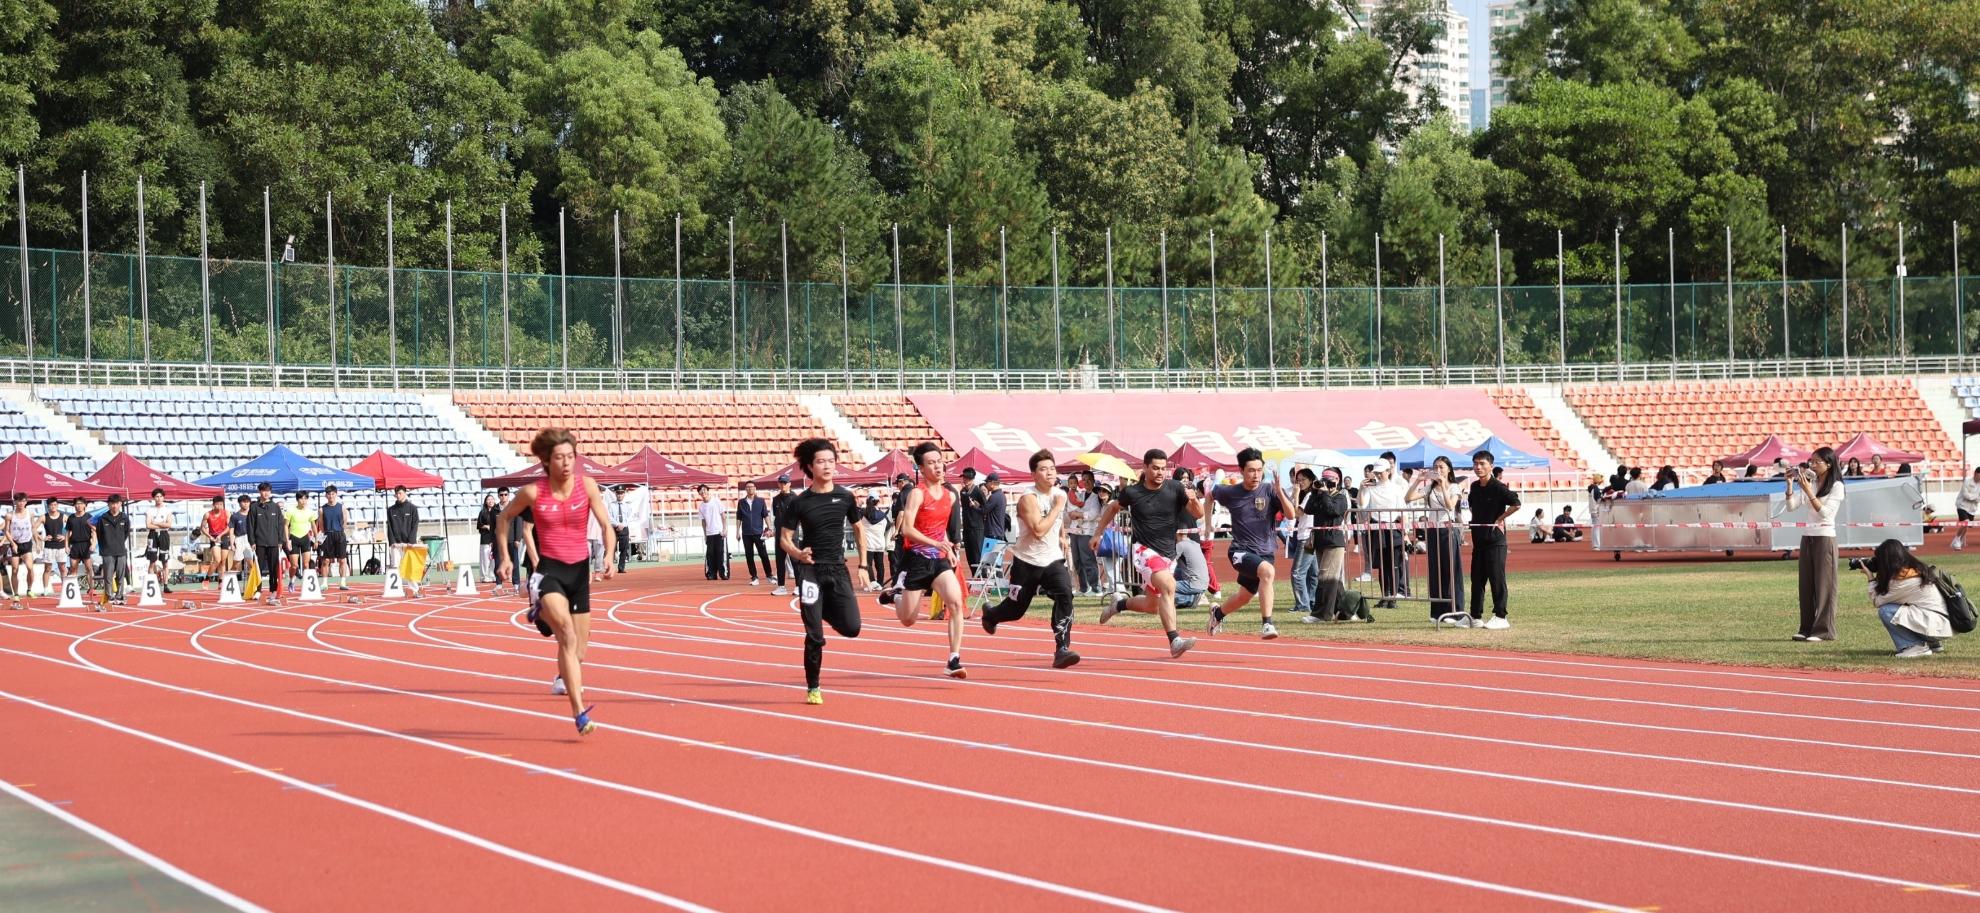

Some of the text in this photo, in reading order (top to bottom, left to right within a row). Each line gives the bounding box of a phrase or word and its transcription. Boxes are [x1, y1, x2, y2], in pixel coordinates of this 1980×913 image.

[969, 419, 1494, 453] 自立 自律 自强
[226, 577, 235, 594] 4
[307, 575, 316, 592] 3
[389, 573, 398, 589] 2
[463, 571, 469, 586] 1
[66, 582, 76, 599] 6
[147, 580, 156, 598] 5
[807, 586, 814, 599] 6
